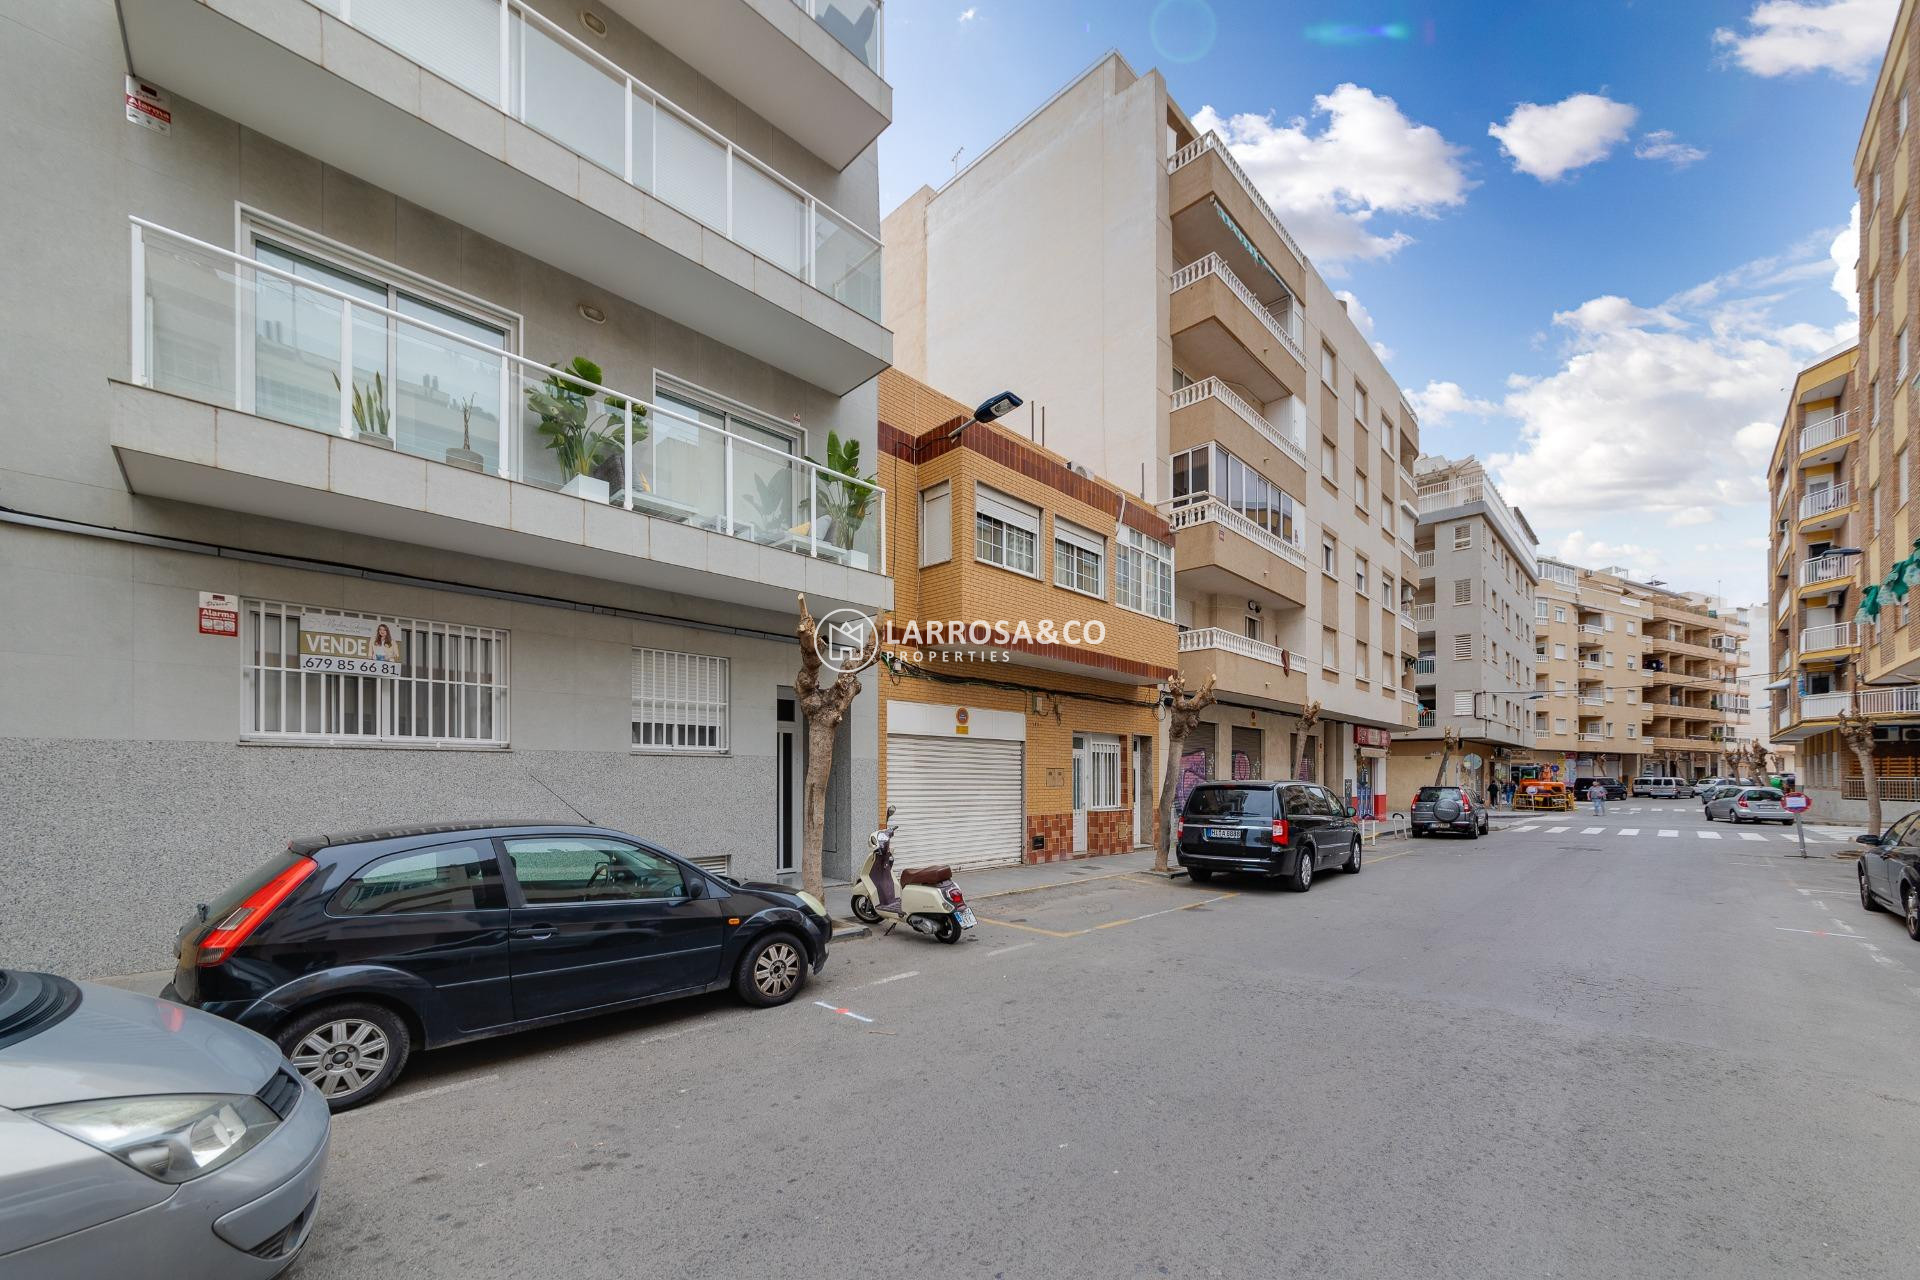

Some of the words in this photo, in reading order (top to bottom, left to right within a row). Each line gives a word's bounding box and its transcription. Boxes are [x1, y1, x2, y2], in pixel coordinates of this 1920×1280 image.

[202, 609, 236, 619] Alarma
[306, 633, 368, 657] VENDE
[306, 657, 332, 669] 679
[337, 660, 355, 671] 85
[360, 662, 377, 673] 66
[381, 663, 396, 675] 81
